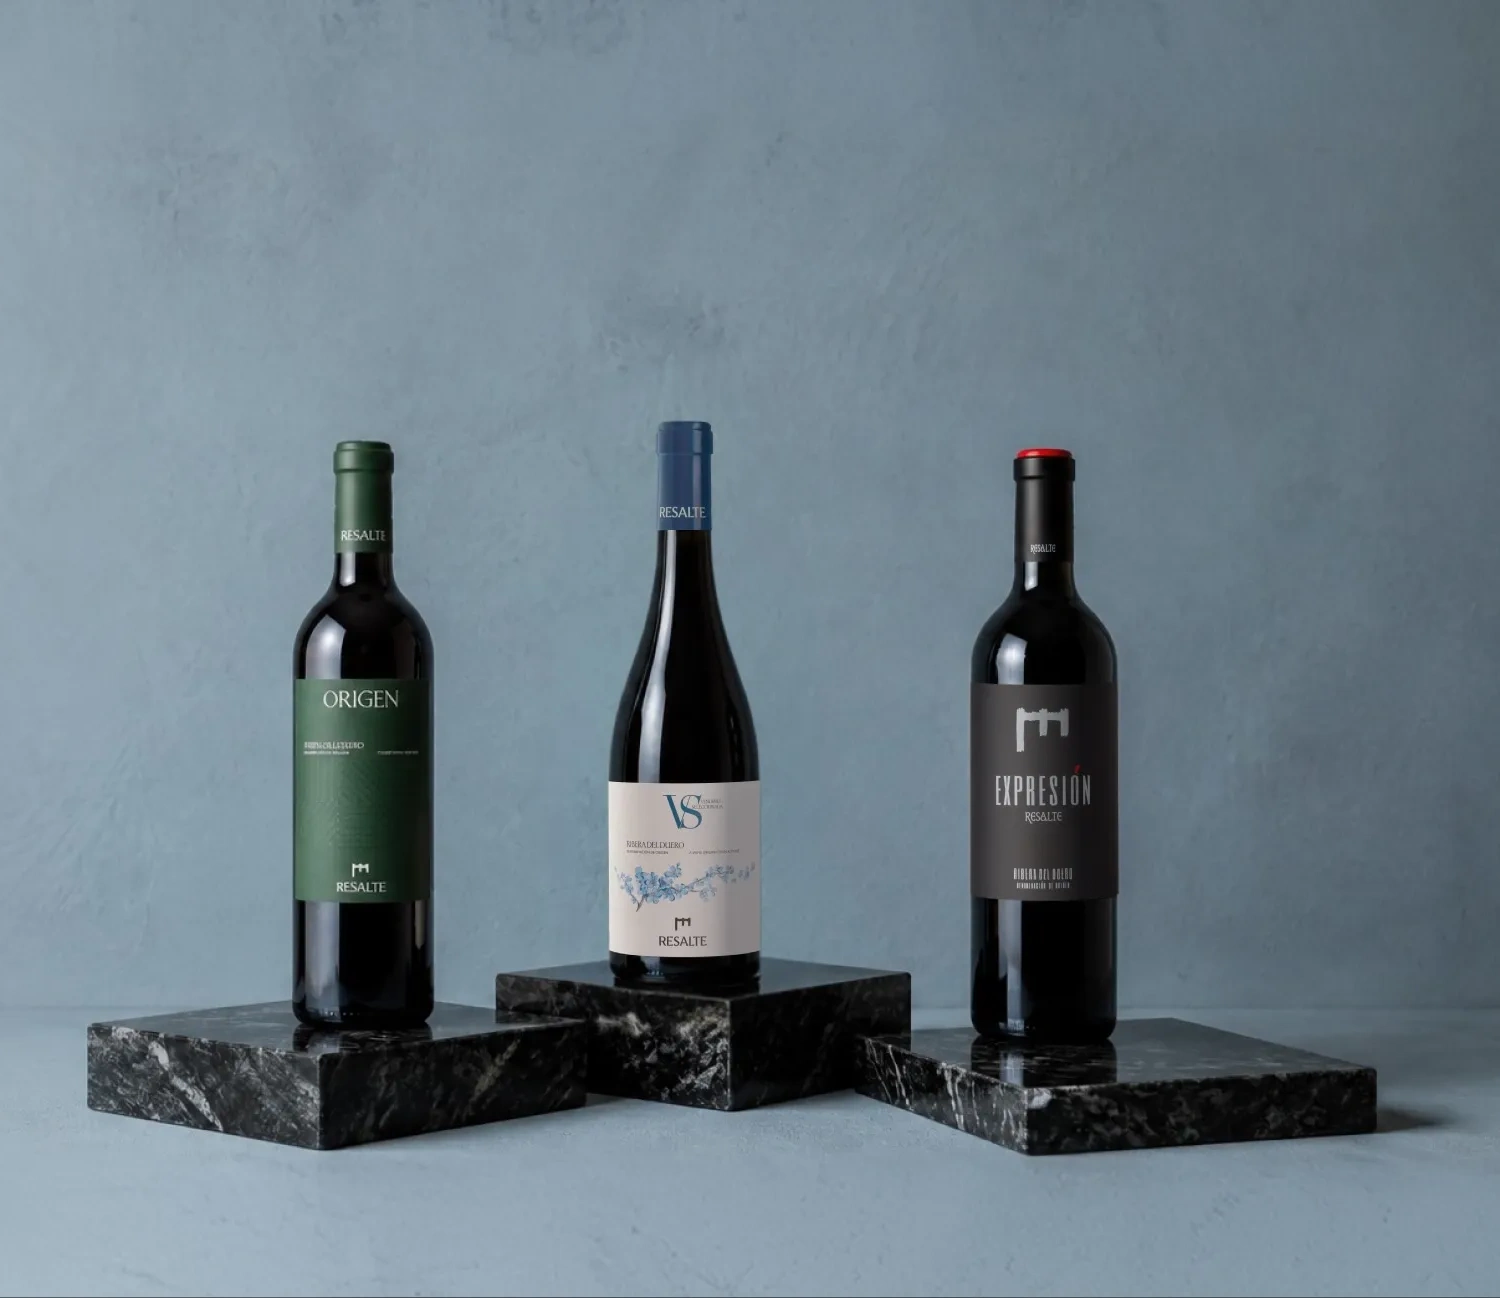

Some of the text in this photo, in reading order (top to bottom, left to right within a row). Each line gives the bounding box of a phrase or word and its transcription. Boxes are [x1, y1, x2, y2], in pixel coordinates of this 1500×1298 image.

[659, 506, 707, 518] RESALTE
[341, 529, 387, 541] RESALTE
[1030, 543, 1057, 554] RESALTE
[323, 690, 399, 708] ORIGEN
[995, 764, 1091, 806] EXPRESIÓN
[662, 794, 702, 829] VS
[1025, 811, 1063, 824] RESALTE
[336, 881, 387, 893] RESALTE
[658, 935, 708, 947] RESALTE
